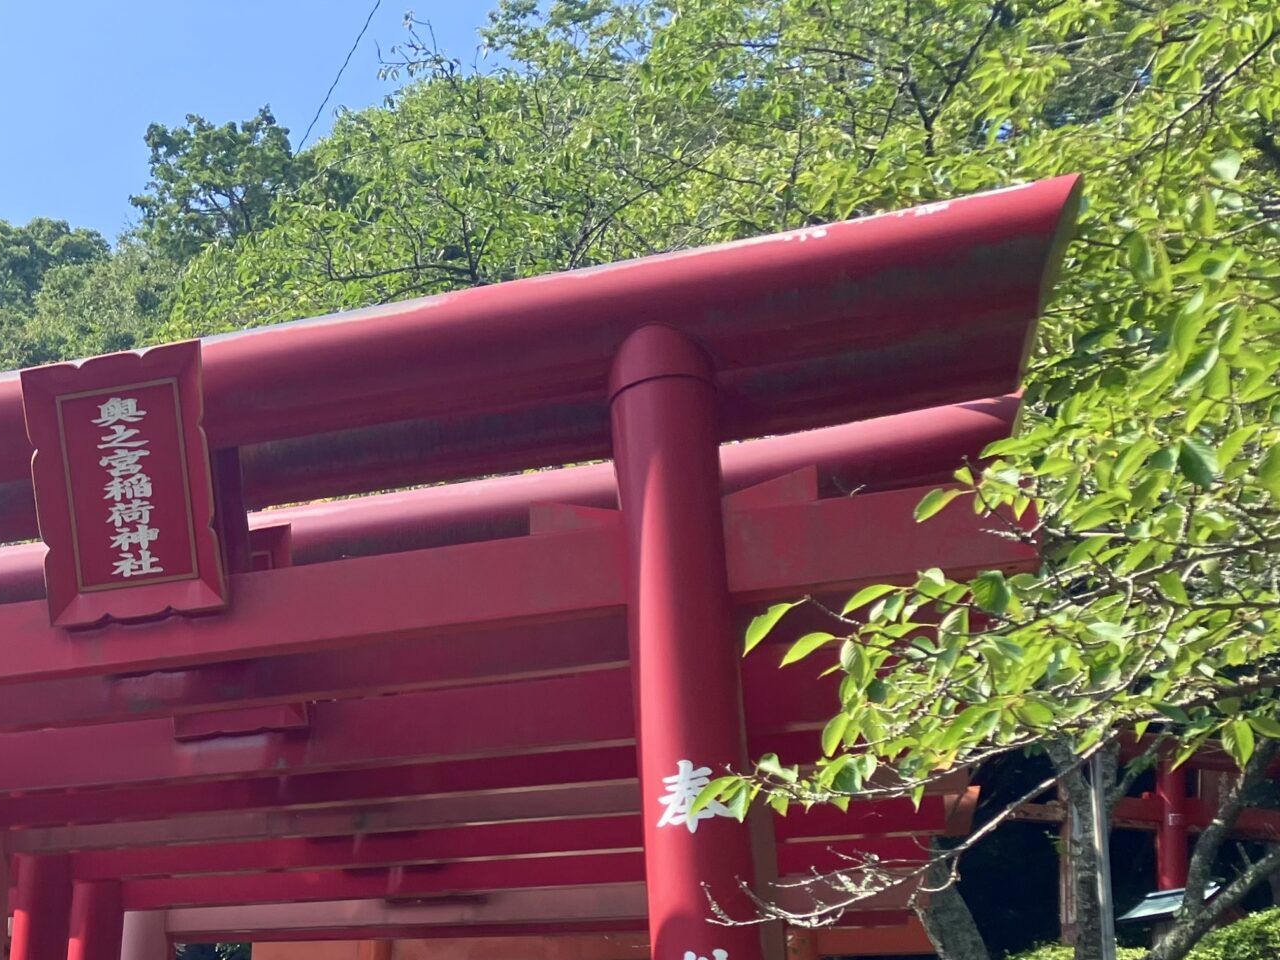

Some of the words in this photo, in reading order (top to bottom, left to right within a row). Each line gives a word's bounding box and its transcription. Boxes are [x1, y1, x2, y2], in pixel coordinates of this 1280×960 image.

[91, 397, 164, 578] 奥之宮稲荷神社
